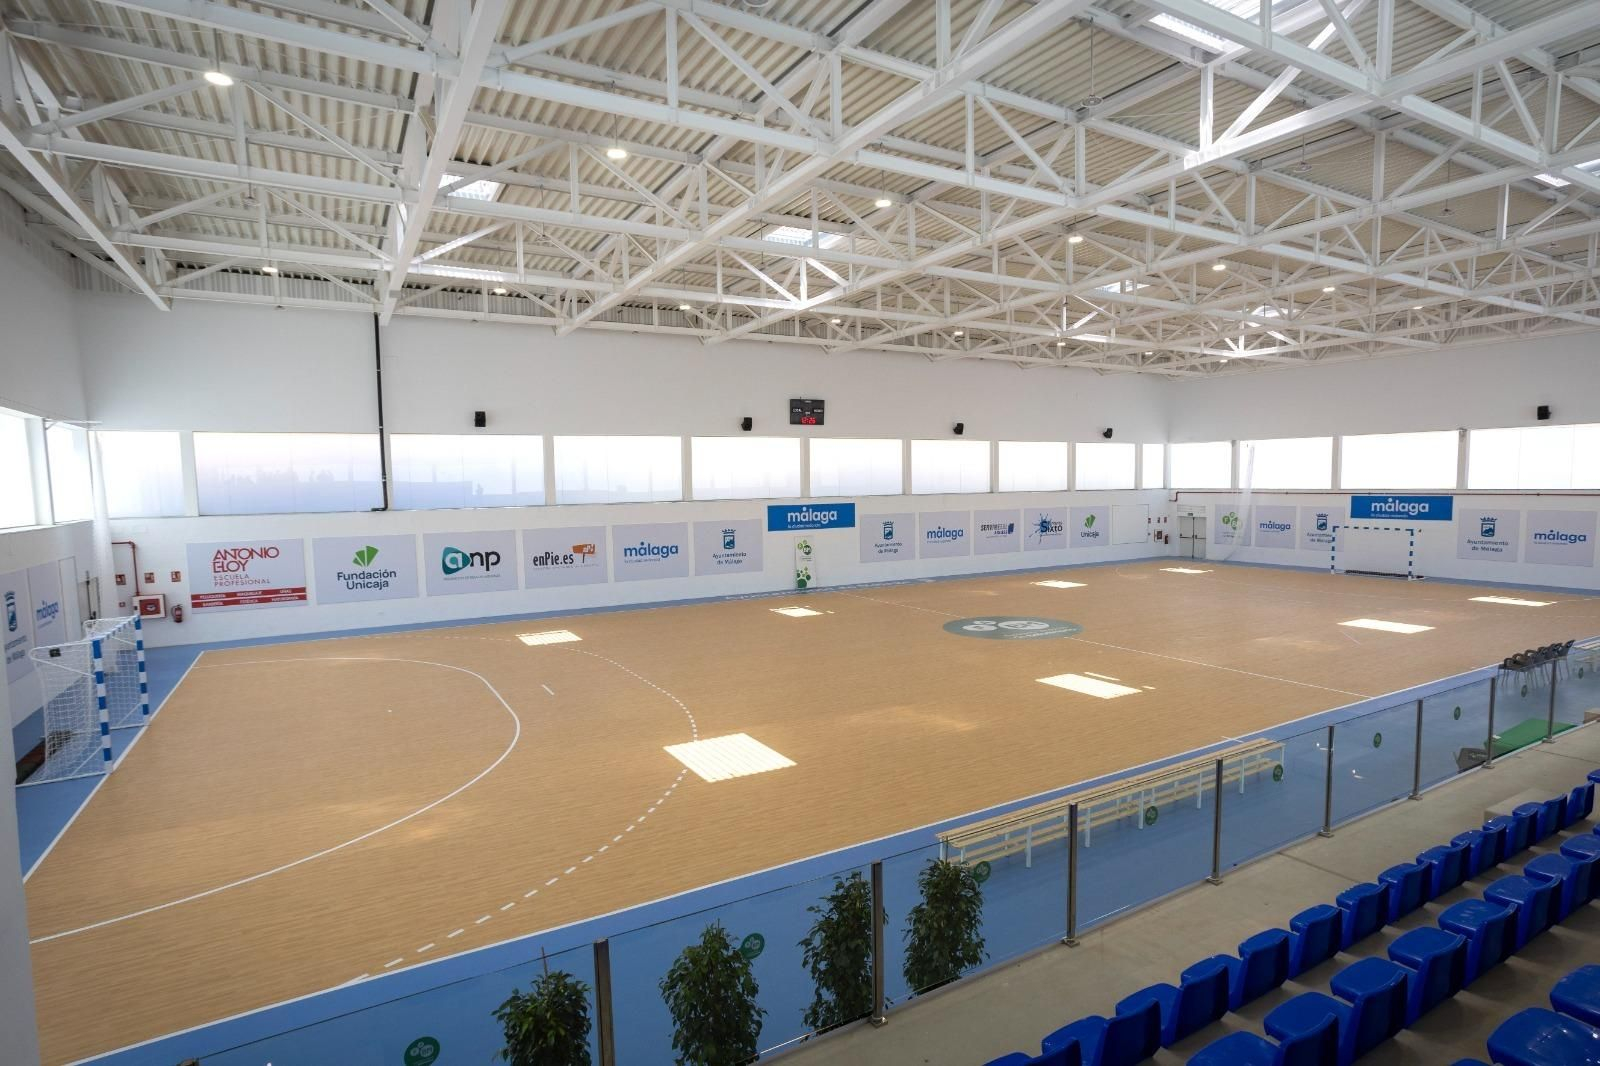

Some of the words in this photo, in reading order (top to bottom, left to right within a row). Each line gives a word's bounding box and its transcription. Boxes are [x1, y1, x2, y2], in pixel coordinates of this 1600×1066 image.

[1466, 538, 1509, 546] Ayuntamiento
[213, 546, 280, 561] ANTONIO
[532, 551, 574, 566] enPie.es
[212, 559, 249, 573] ELOY
[213, 573, 250, 581] ESCUELA
[337, 569, 397, 581] Fundación
[214, 578, 271, 587] PROFESIONAL
[346, 579, 389, 591] Unicaja
